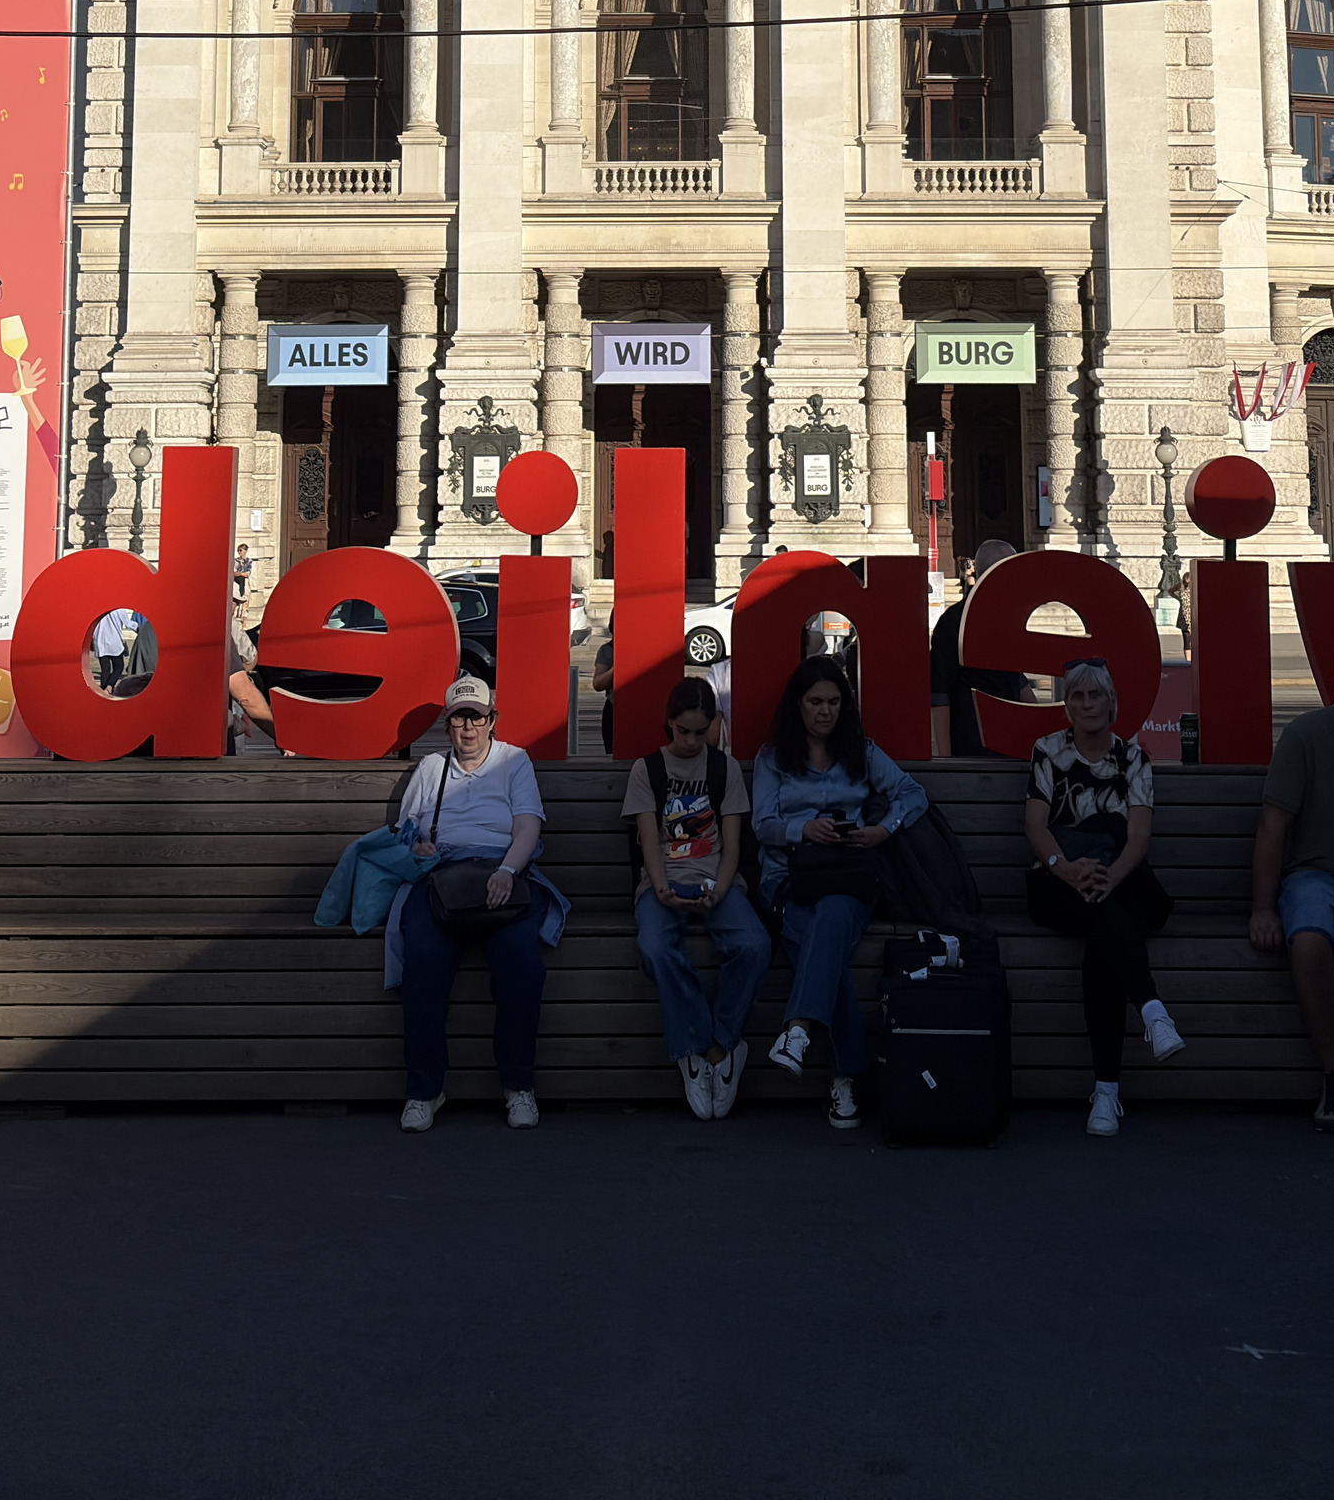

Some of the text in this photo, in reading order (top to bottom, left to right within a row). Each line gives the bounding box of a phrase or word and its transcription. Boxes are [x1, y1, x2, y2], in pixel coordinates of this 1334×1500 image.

[288, 342, 368, 368] ALLES
[615, 341, 689, 366] WIRD
[938, 341, 1013, 366] BURG
